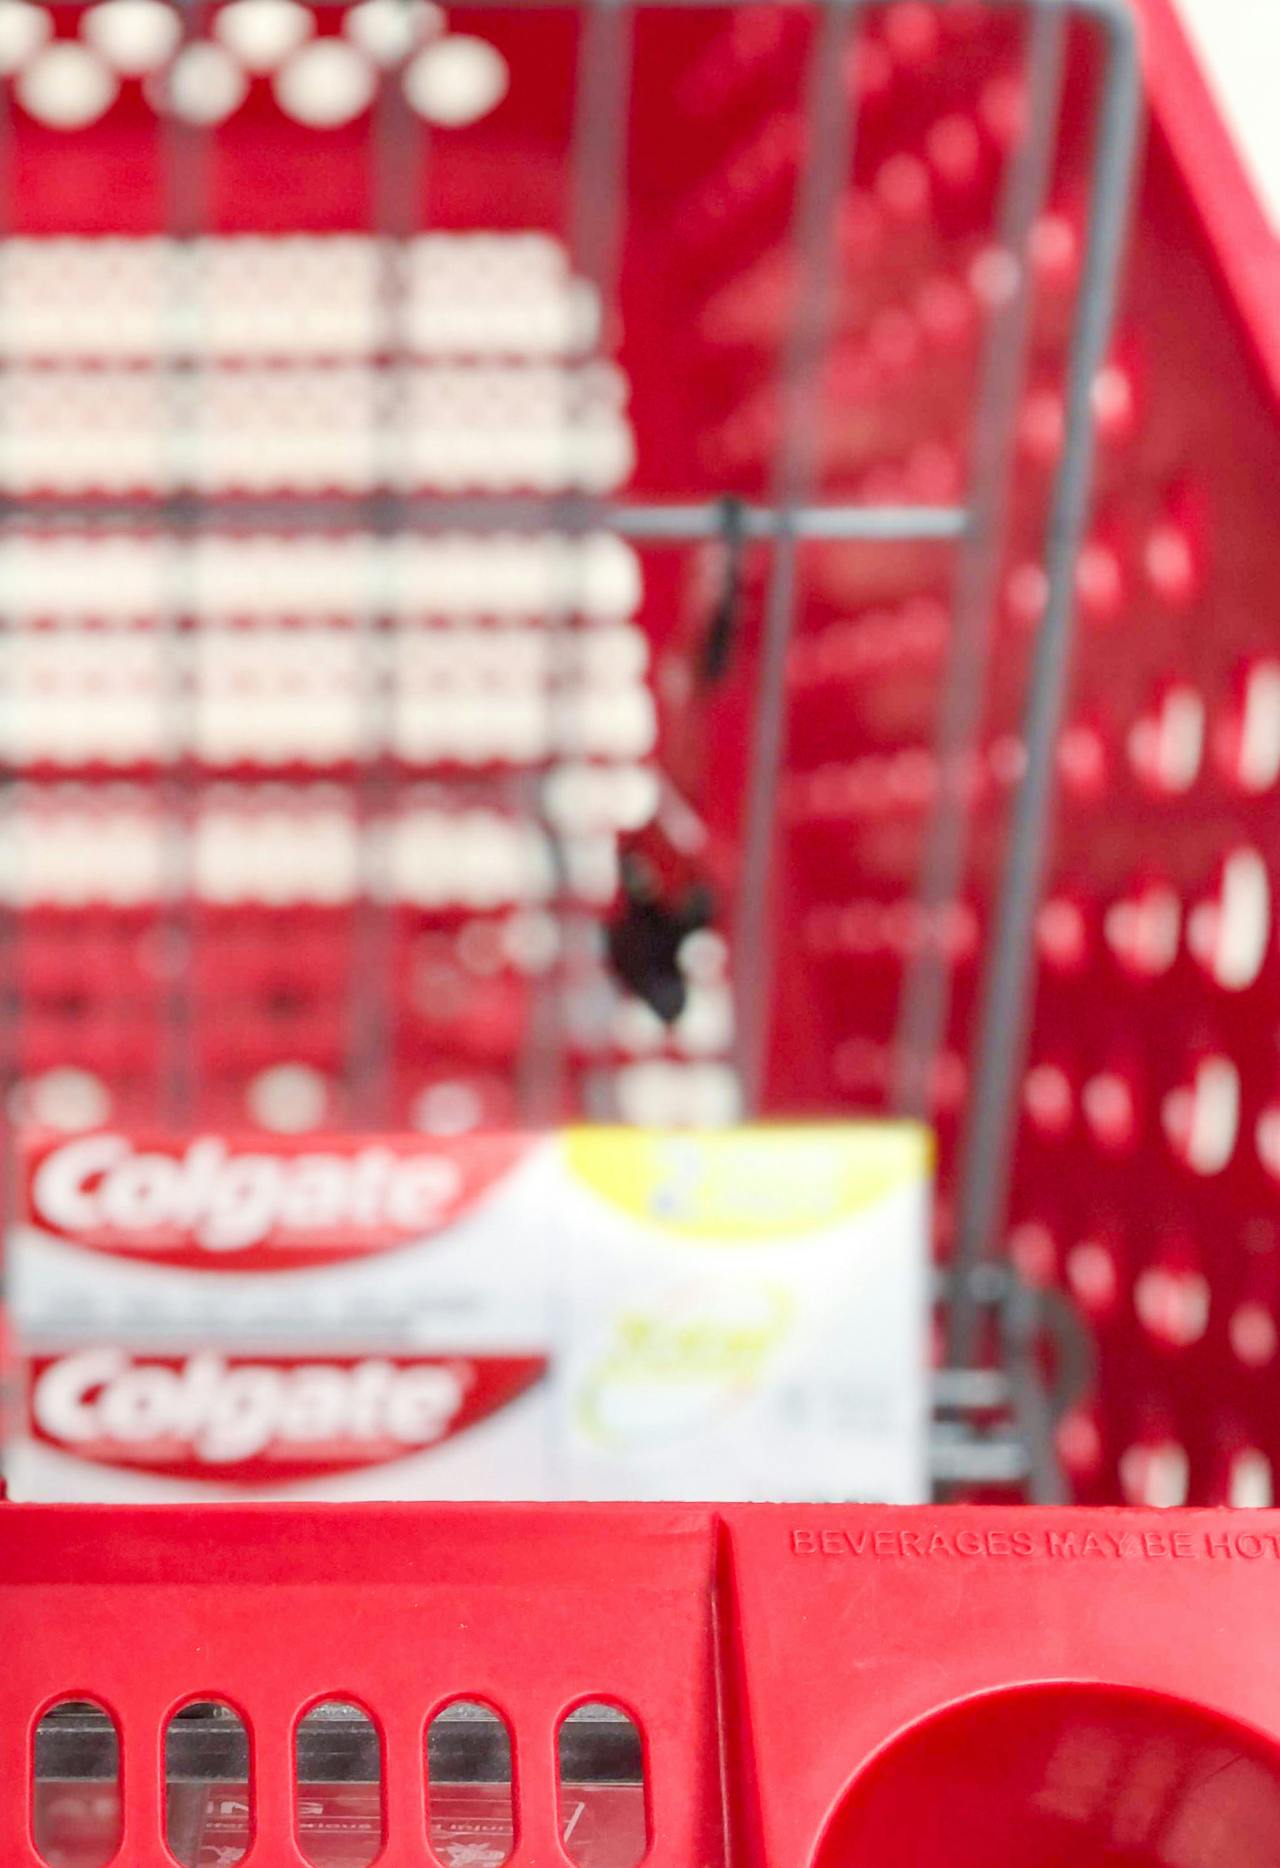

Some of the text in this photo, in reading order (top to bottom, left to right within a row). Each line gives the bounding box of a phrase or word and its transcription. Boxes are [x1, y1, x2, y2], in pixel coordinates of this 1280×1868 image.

[33, 1133, 460, 1252] Colgate
[33, 1347, 463, 1463] Colgate
[790, 1528, 1035, 1558] BEVERAGES
[1046, 1530, 1130, 1559] MAY
[1140, 1531, 1197, 1560] BE
